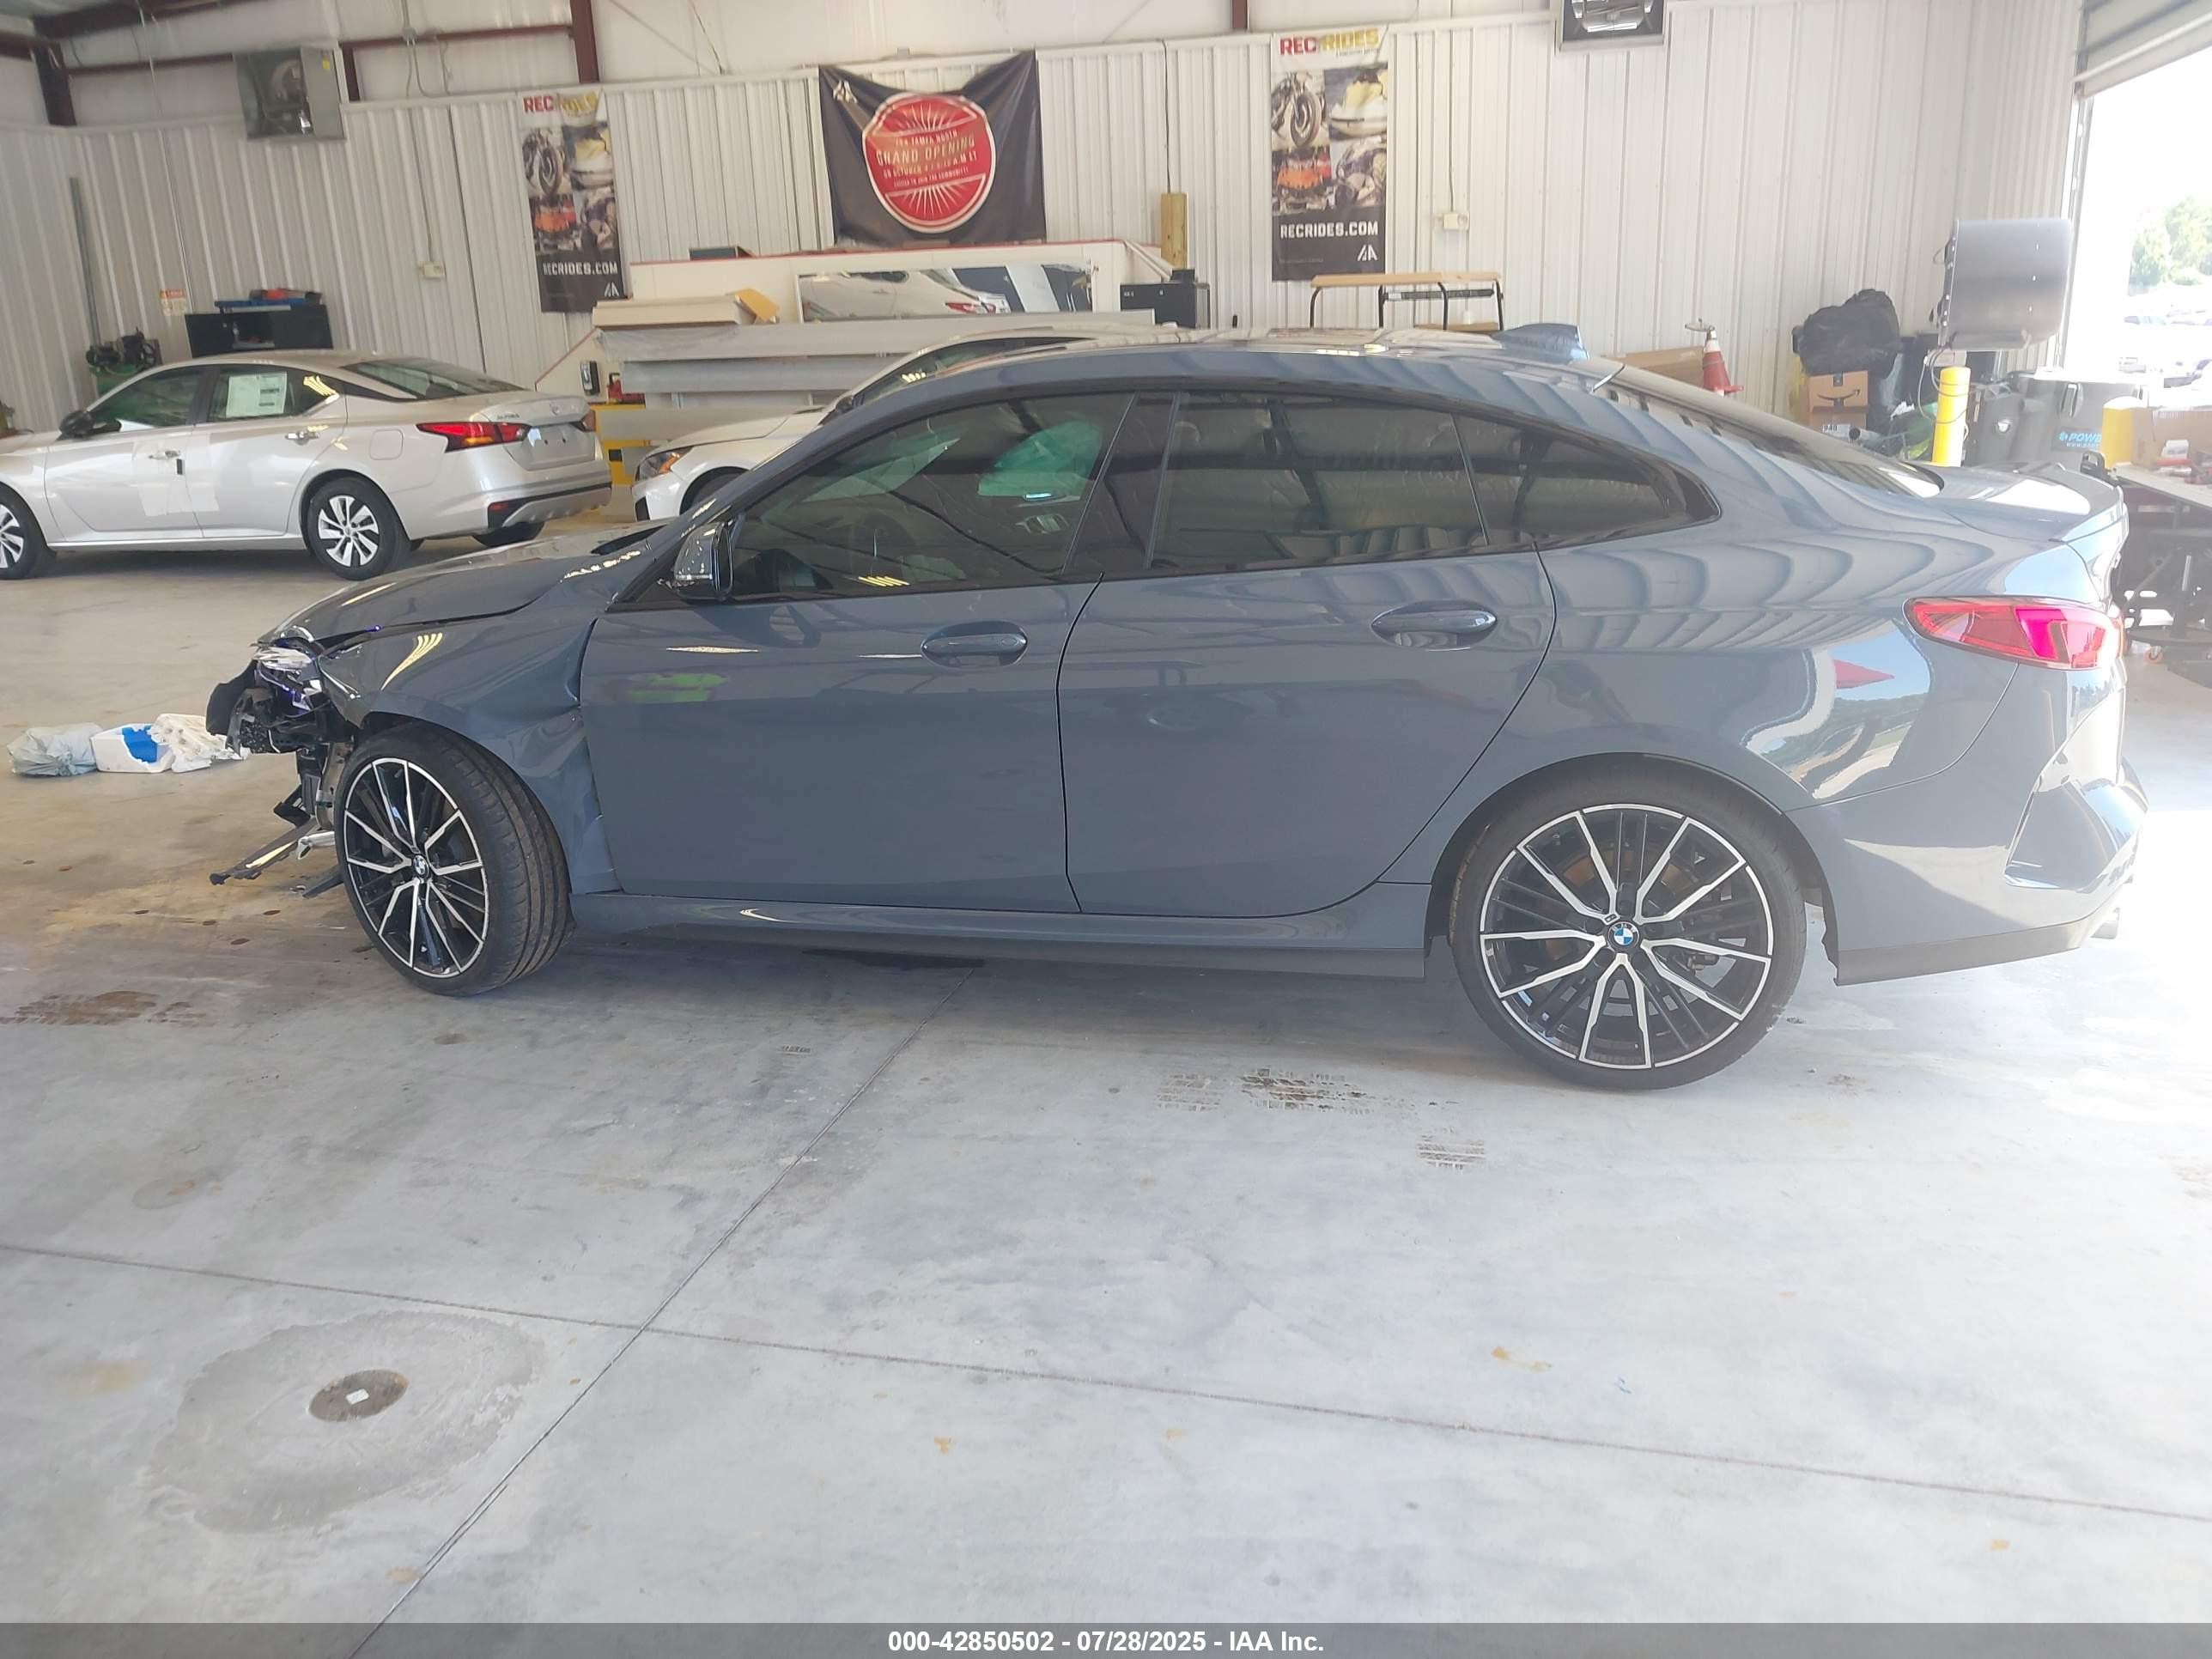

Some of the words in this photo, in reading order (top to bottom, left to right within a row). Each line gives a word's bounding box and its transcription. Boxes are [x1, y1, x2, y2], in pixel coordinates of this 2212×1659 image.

[1279, 37, 1318, 56] REC
[1321, 27, 1379, 51] RIDES
[523, 95, 554, 113] REC
[876, 149, 919, 166] GRAND
[925, 134, 975, 160] OPENING
[1279, 221, 1379, 240] RECRIDES.COM
